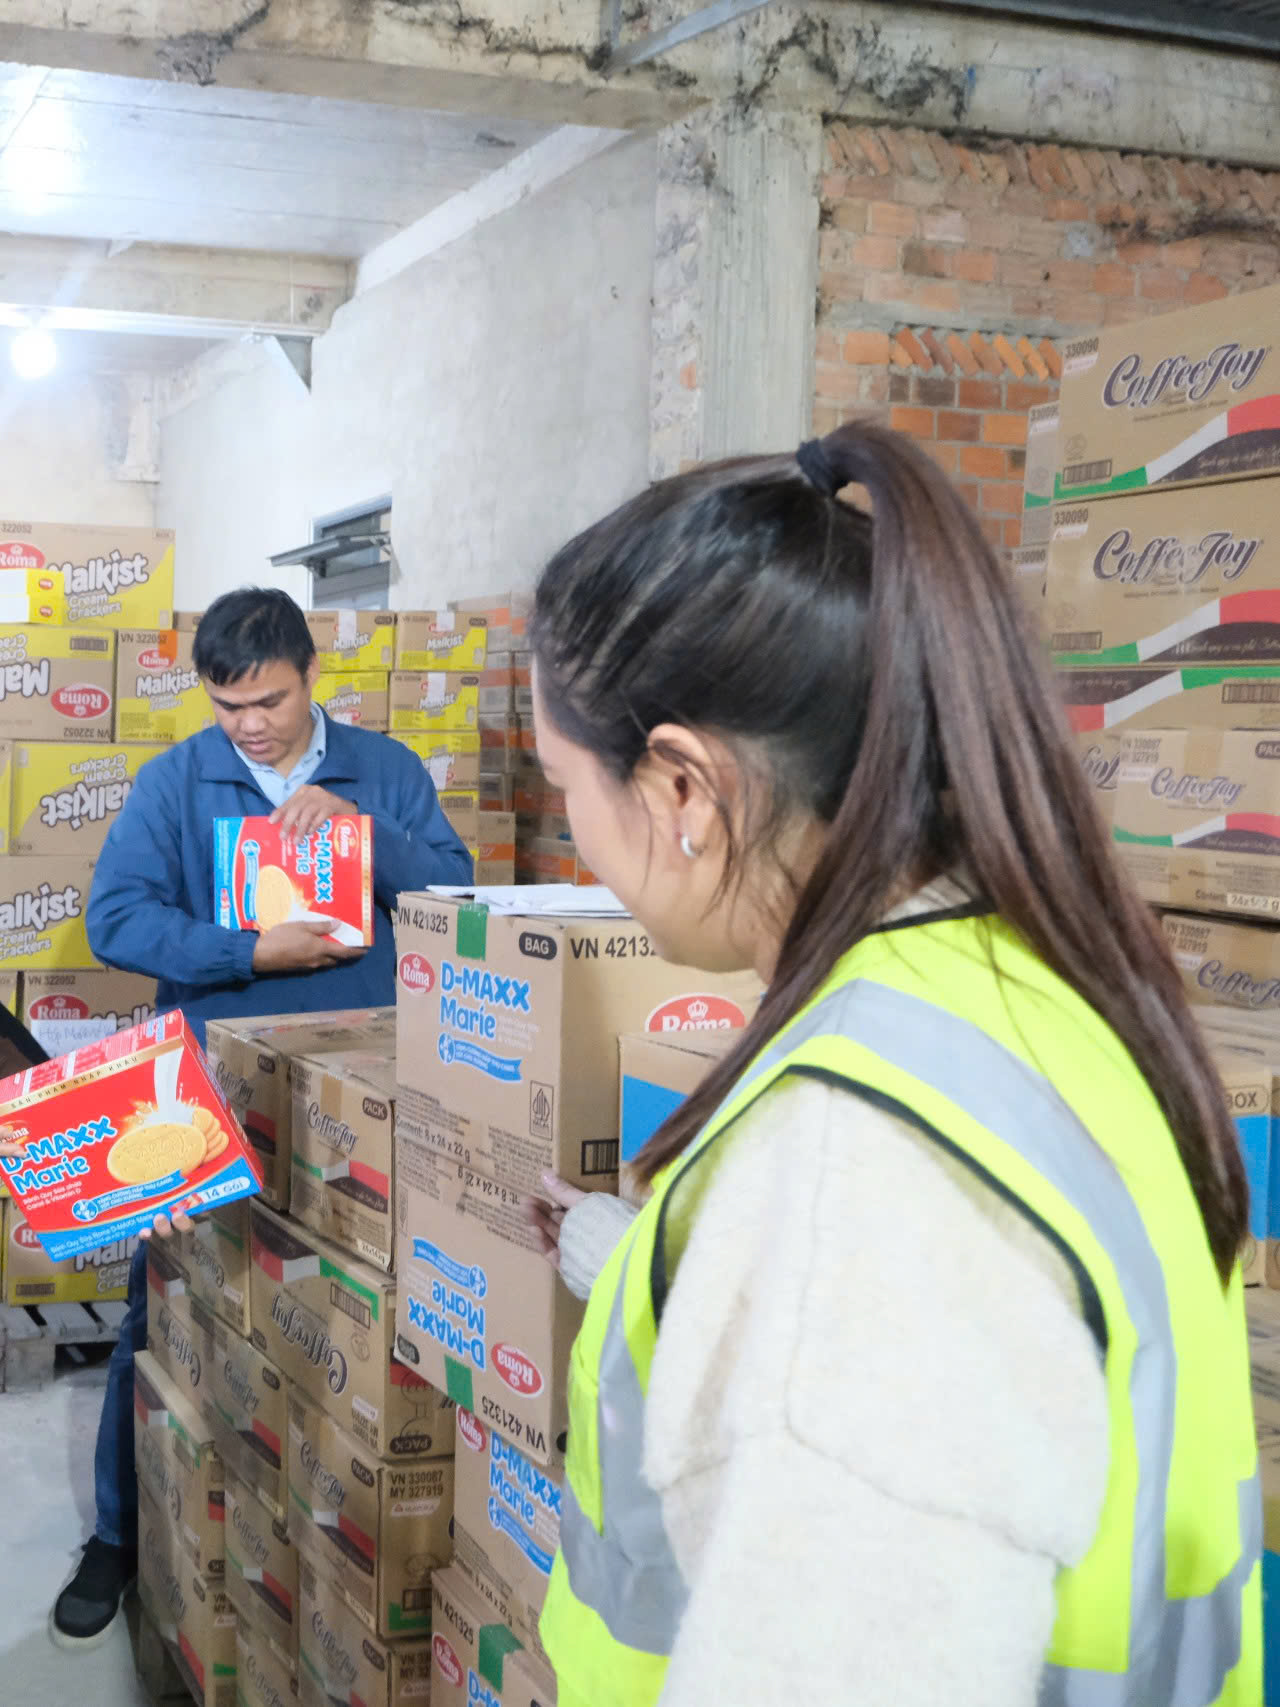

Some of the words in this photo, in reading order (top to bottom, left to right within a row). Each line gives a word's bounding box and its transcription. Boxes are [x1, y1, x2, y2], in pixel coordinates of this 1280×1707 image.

[1065, 337, 1099, 359] 330090
[1054, 509, 1088, 525] 330090
[121, 634, 134, 643] VN
[427, 634, 464, 650] Malkist
[137, 667, 200, 697] Malkist
[60, 690, 102, 710] Roma
[63, 727, 94, 738] 322052
[71, 754, 128, 775] Crackers
[84, 768, 127, 784] Cream
[296, 836, 313, 875] arie
[397, 907, 411, 925] VN
[412, 909, 448, 934] 421325
[524, 936, 550, 955] BAG
[570, 938, 599, 958] VN
[605, 936, 657, 958] 4213
[28, 976, 42, 985] VN
[403, 962, 430, 987] Roma
[440, 960, 531, 1012] D-MAXX
[37, 1005, 81, 1020] Roma
[439, 995, 497, 1039] Marie
[363, 1100, 387, 1119] PACK
[0, 1116, 118, 1173] D-MAXX
[10, 1156, 90, 1195] Marie
[205, 1188, 219, 1199] 14
[431, 1280, 485, 1336] Marie
[408, 1296, 486, 1370] D-MAXX
[496, 1348, 534, 1387] Roma
[460, 1406, 485, 1445] Roma
[481, 1395, 523, 1431] 421325
[395, 1438, 429, 1450] PACK
[526, 1423, 547, 1453] VN
[352, 1460, 372, 1485] PACK
[390, 1473, 406, 1485] VN
[389, 1486, 405, 1498] MY
[408, 1484, 443, 1498] 327919
[490, 1460, 536, 1528] Marie
[443, 1601, 474, 1646] 421325
[435, 1643, 458, 1679] Roma
